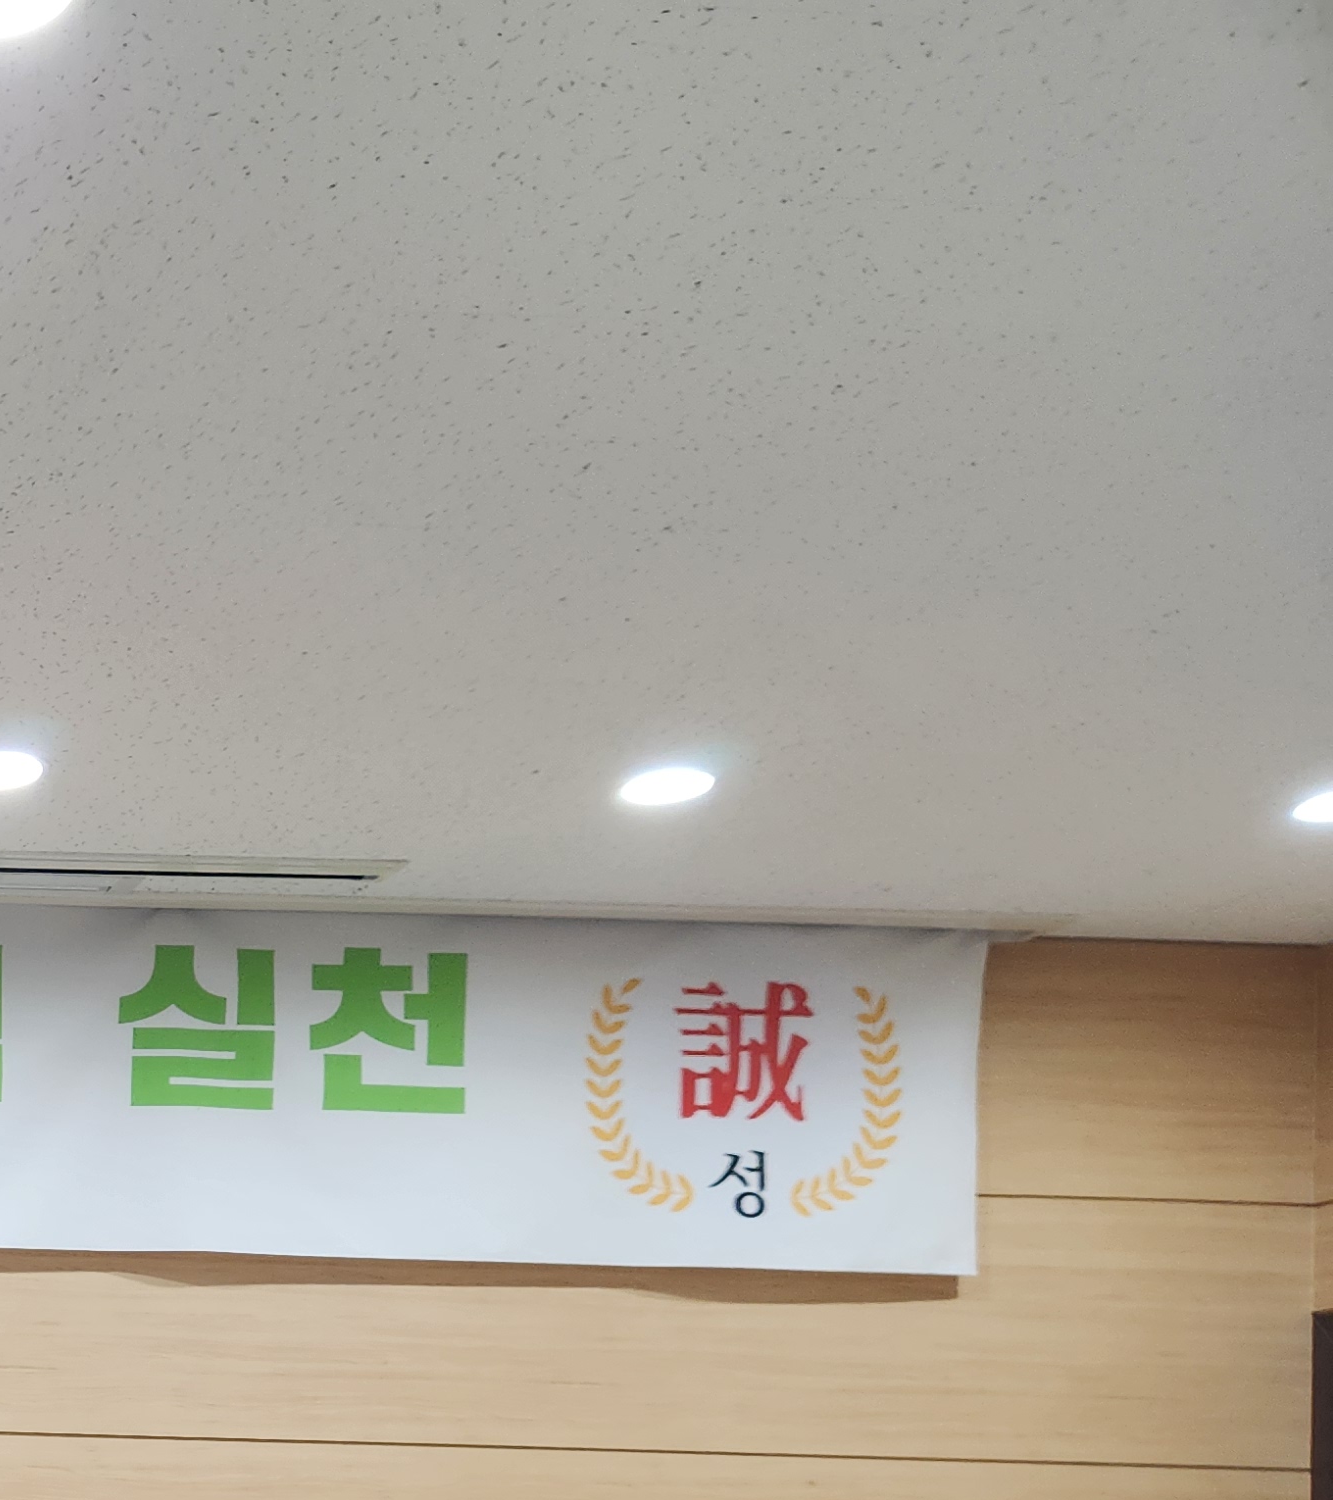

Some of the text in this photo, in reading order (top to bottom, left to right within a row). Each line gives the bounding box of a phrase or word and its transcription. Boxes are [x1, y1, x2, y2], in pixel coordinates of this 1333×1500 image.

[119, 945, 467, 1113] 실천
[678, 982, 812, 1121] 誠
[707, 1150, 770, 1220] 성
